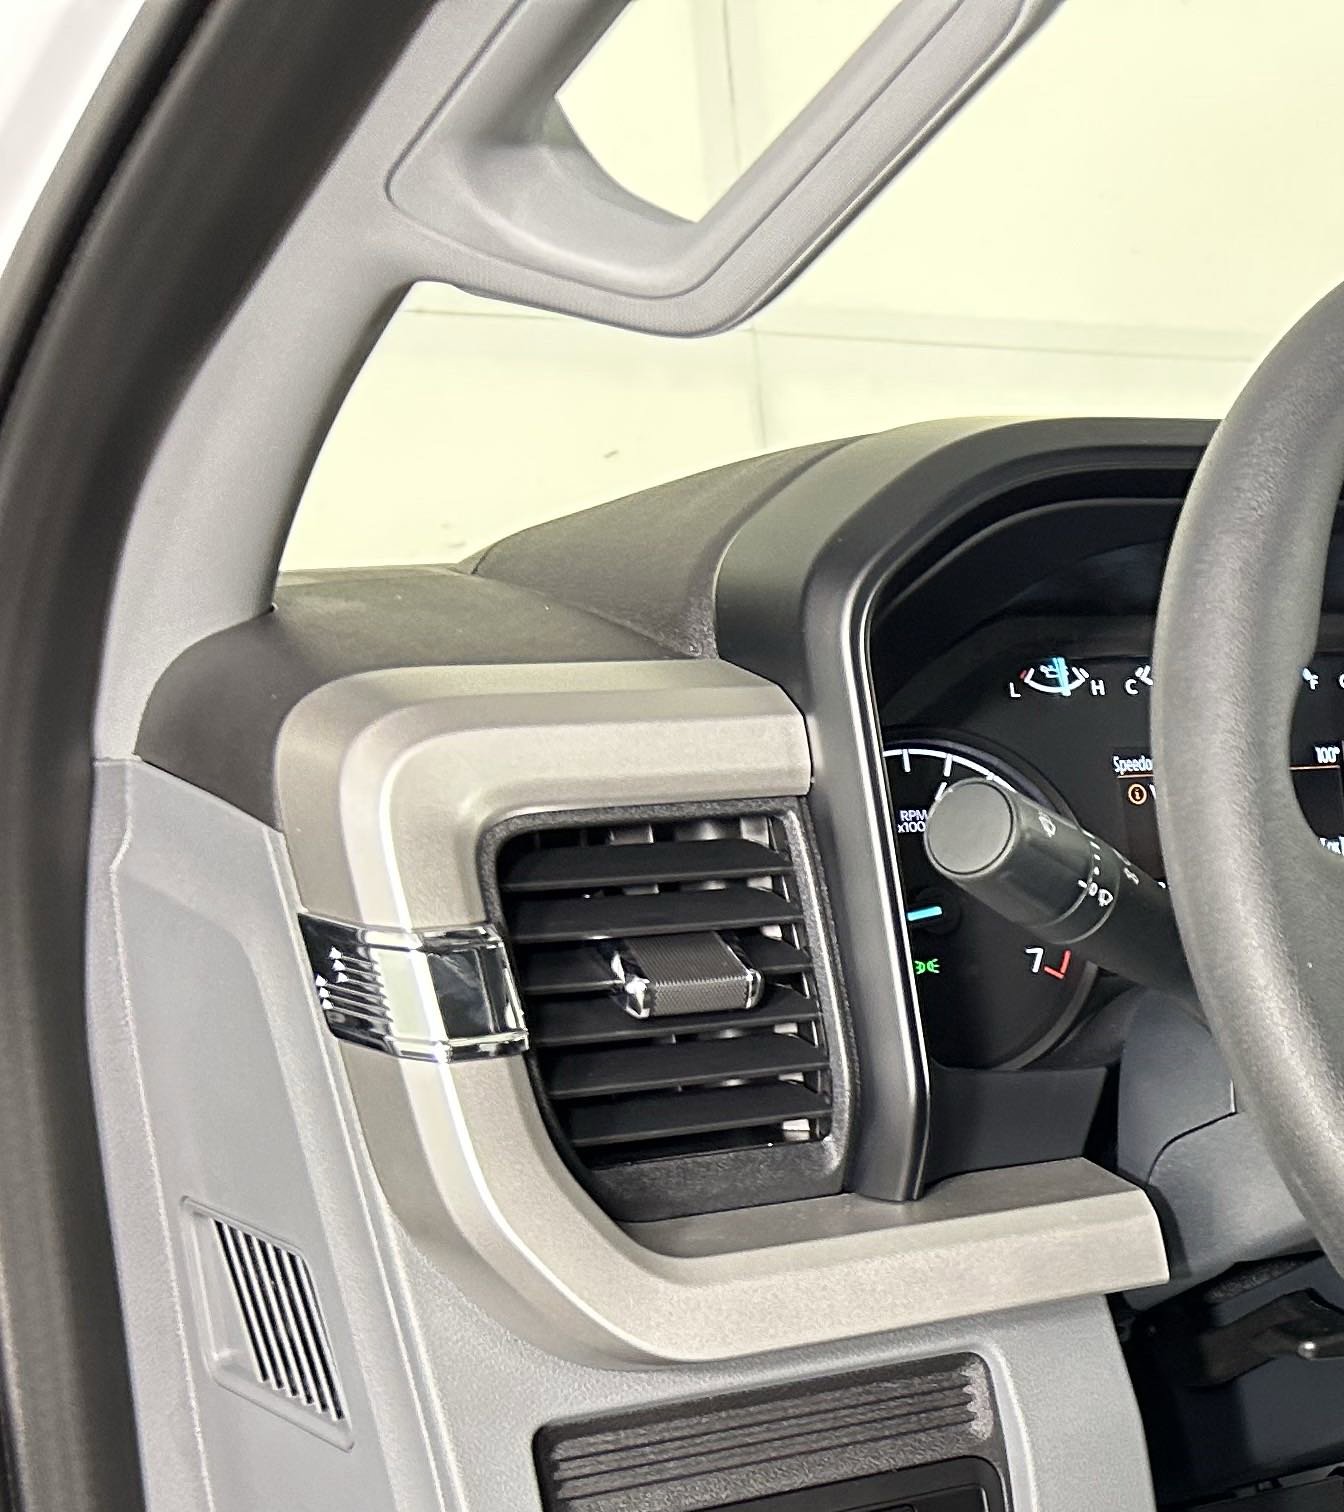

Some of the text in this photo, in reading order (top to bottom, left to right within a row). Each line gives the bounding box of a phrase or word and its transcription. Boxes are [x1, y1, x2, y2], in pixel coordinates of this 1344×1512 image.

[1009, 682, 1021, 698] L
[1090, 679, 1106, 696] H
[1124, 678, 1139, 695] C
[1112, 755, 1153, 776] Speedo
[899, 810, 929, 822] RPM
[897, 820, 927, 834] x100
[1025, 947, 1044, 973] 7
